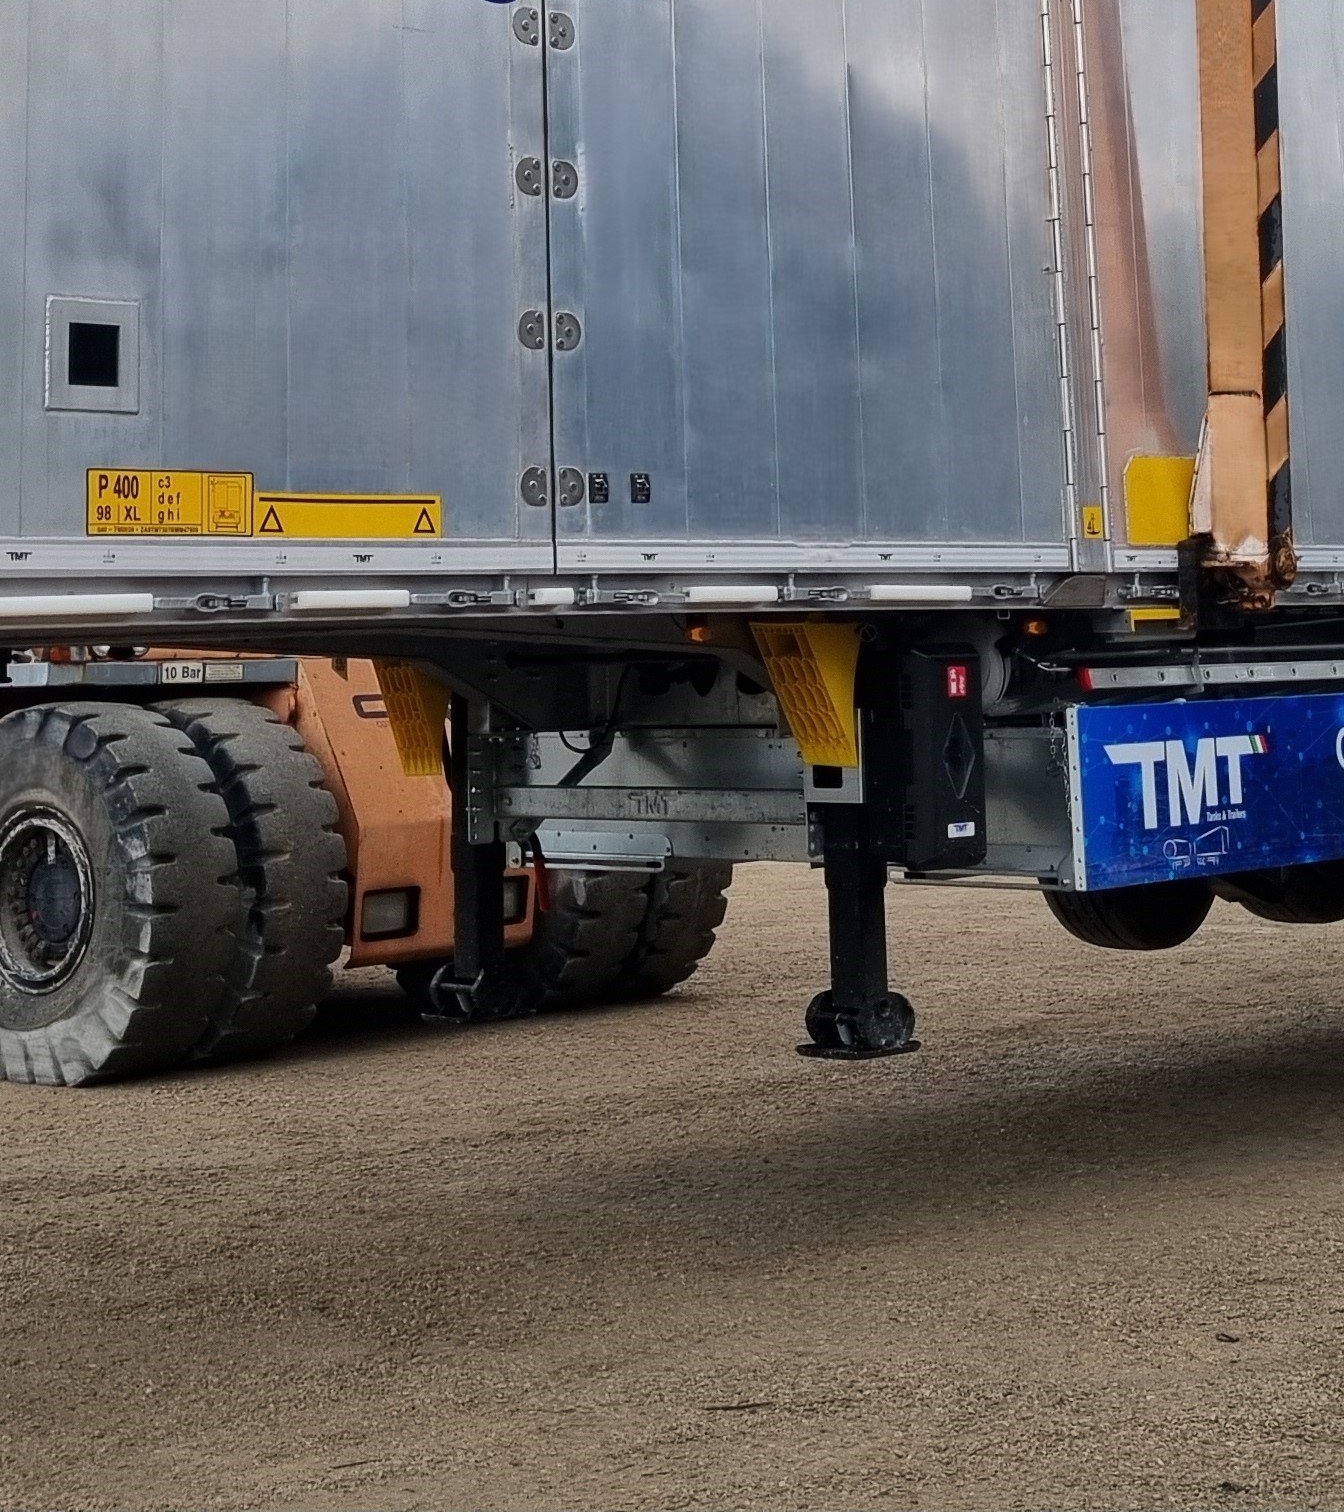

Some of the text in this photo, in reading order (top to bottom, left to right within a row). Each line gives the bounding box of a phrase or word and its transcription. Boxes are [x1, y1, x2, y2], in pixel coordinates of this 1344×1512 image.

[98, 474, 139, 500] P 400
[158, 476, 171, 488] c3
[97, 506, 111, 520] 98
[124, 506, 141, 521] XL
[6, 551, 32, 561] TMT
[165, 666, 176, 680] 10
[182, 666, 201, 679] Bar
[1103, 735, 1254, 830] TMT
